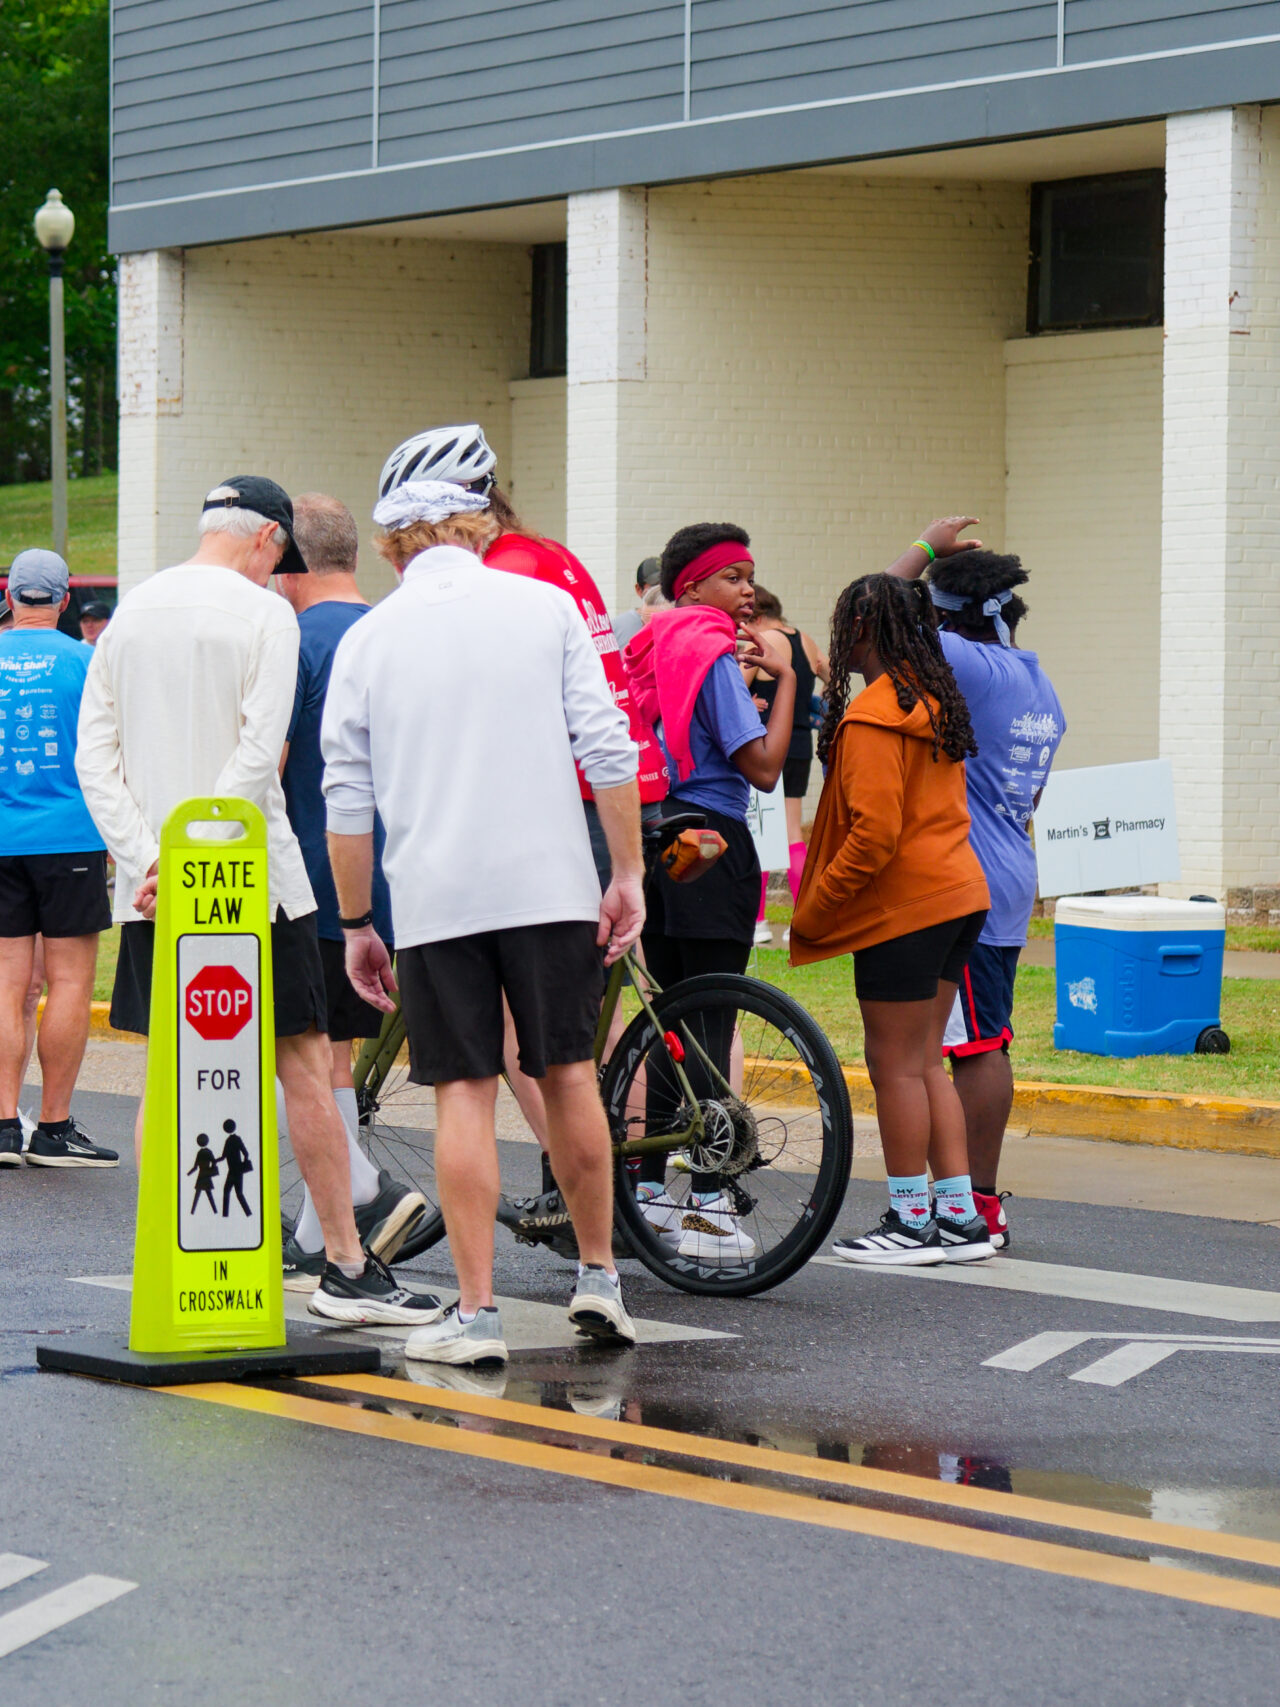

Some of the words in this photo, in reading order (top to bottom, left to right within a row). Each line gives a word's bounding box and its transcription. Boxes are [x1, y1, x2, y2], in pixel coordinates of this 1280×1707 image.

[1047, 825, 1088, 841] Martin's
[1115, 818, 1166, 832] Pharmacy
[182, 861, 255, 889] STATE
[194, 897, 243, 925] LAW
[189, 989, 249, 1017] STOP
[197, 1069, 241, 1091] FOR
[214, 1260, 228, 1281] IN
[179, 1289, 263, 1312] CROSSWALK
